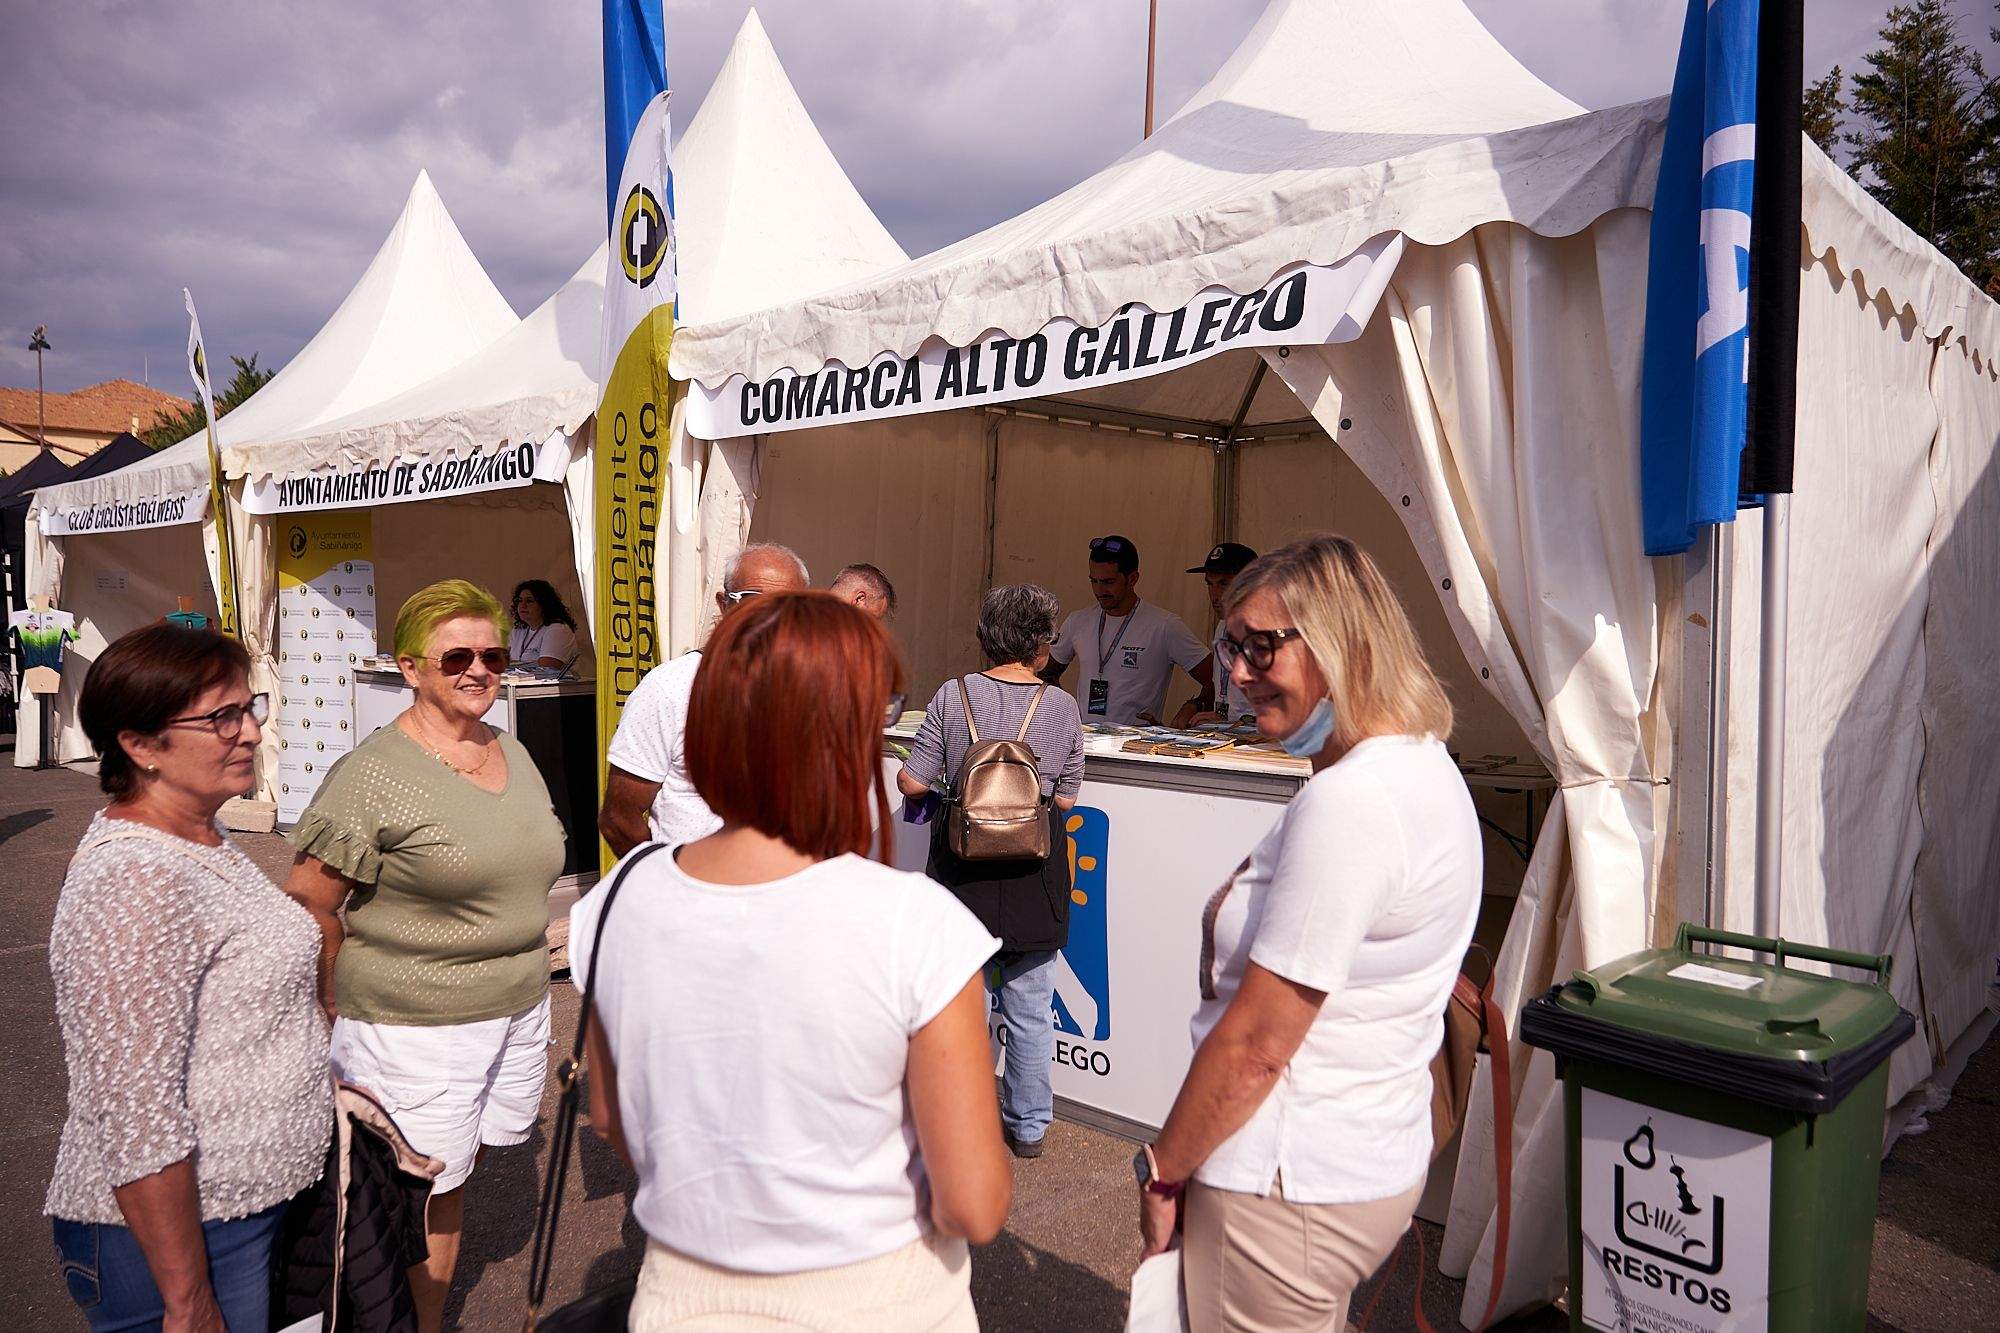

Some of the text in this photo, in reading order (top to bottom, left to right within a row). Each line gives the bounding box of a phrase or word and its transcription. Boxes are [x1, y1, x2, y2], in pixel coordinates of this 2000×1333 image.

[740, 271, 1307, 426] COMARCA ALTO GÁLLEGO
[279, 469, 390, 507] AYUNTAMIENTO
[392, 463, 417, 496] DE
[68, 496, 186, 531] CLUB CICLISTA EDELWEISS
[1602, 1246, 1732, 1313] RESTOS
